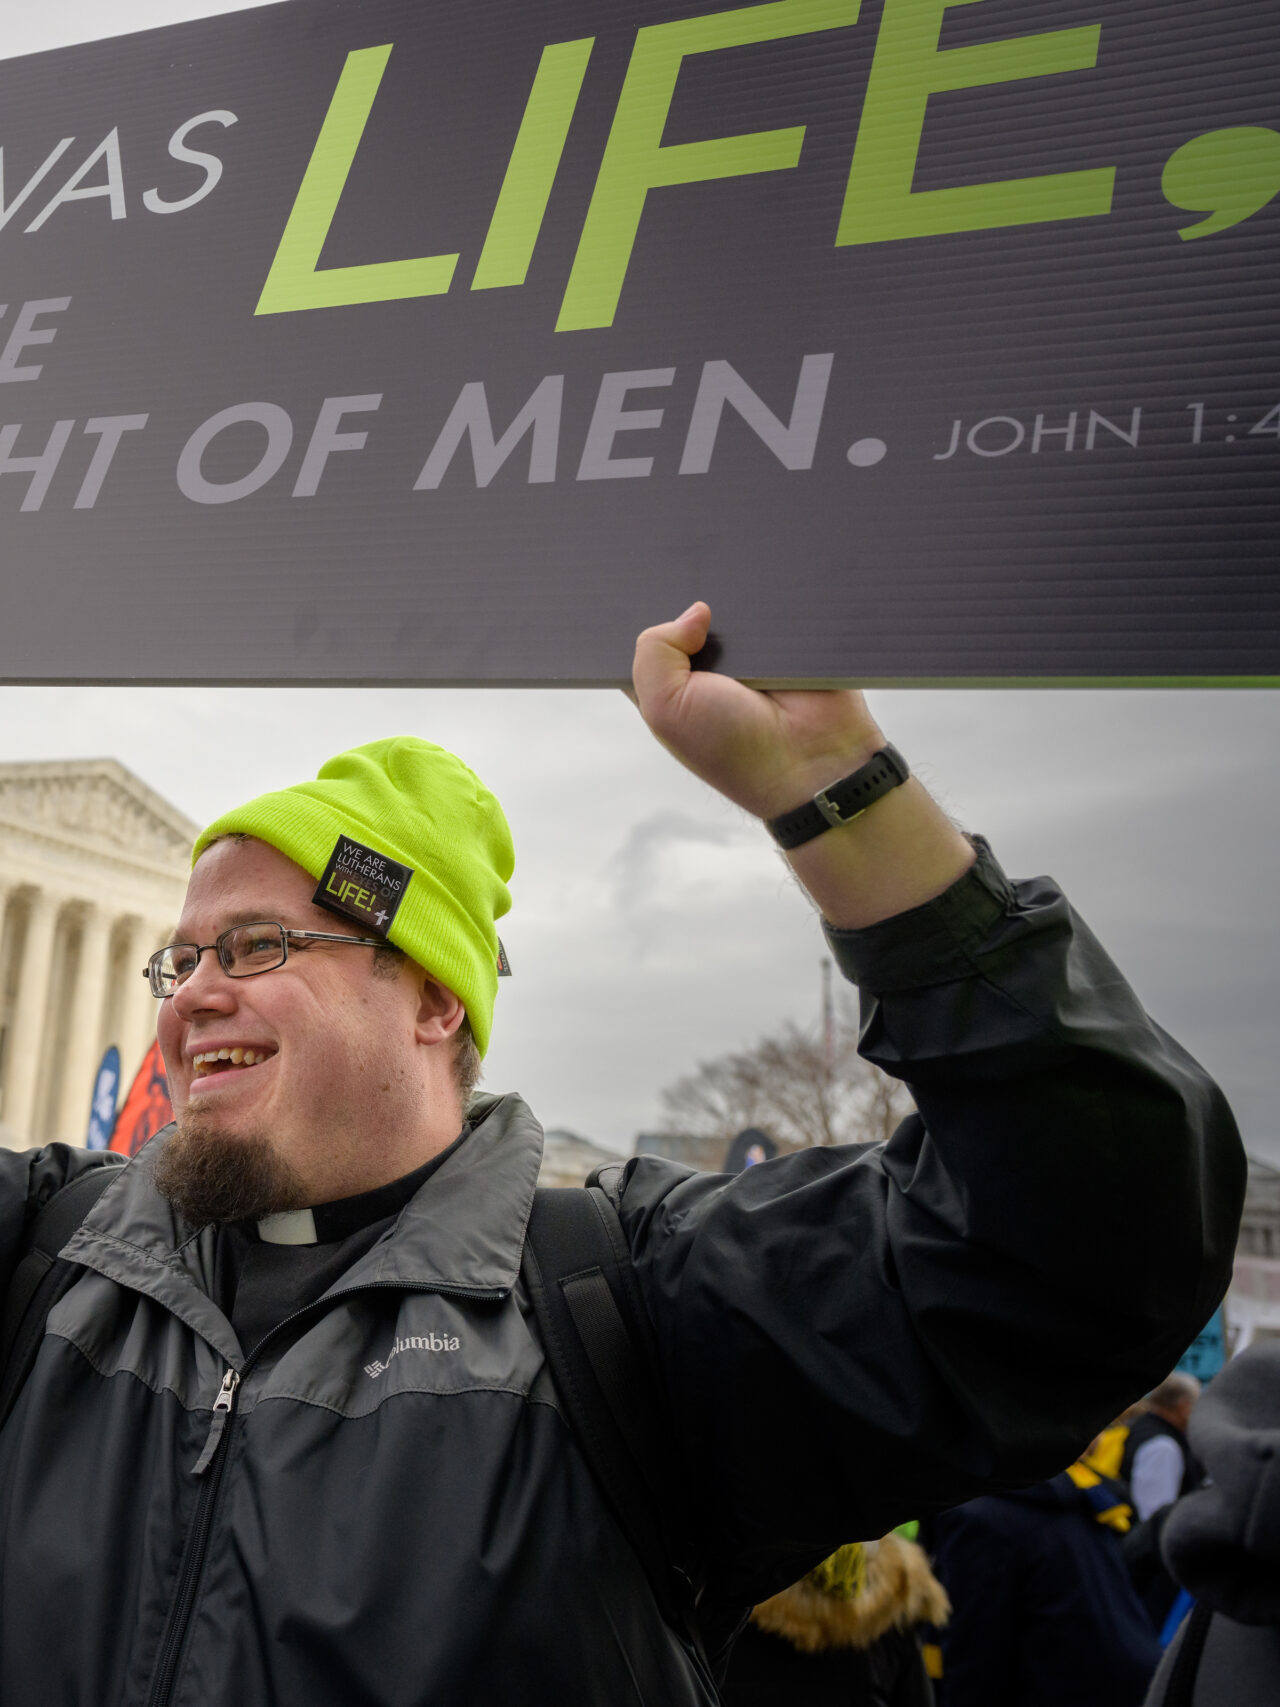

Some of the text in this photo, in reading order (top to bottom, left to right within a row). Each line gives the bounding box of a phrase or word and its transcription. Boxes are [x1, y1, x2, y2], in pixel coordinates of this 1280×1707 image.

[254, 0, 1280, 332] LIFE,
[176, 393, 384, 506] OF
[412, 352, 887, 492] MEN.
[932, 402, 1280, 460] JOHN 1:4
[335, 863, 353, 876] WITH
[337, 852, 401, 891] LUTHERANS
[343, 842, 387, 872] WE ARE
[325, 871, 376, 912] LIFE!
